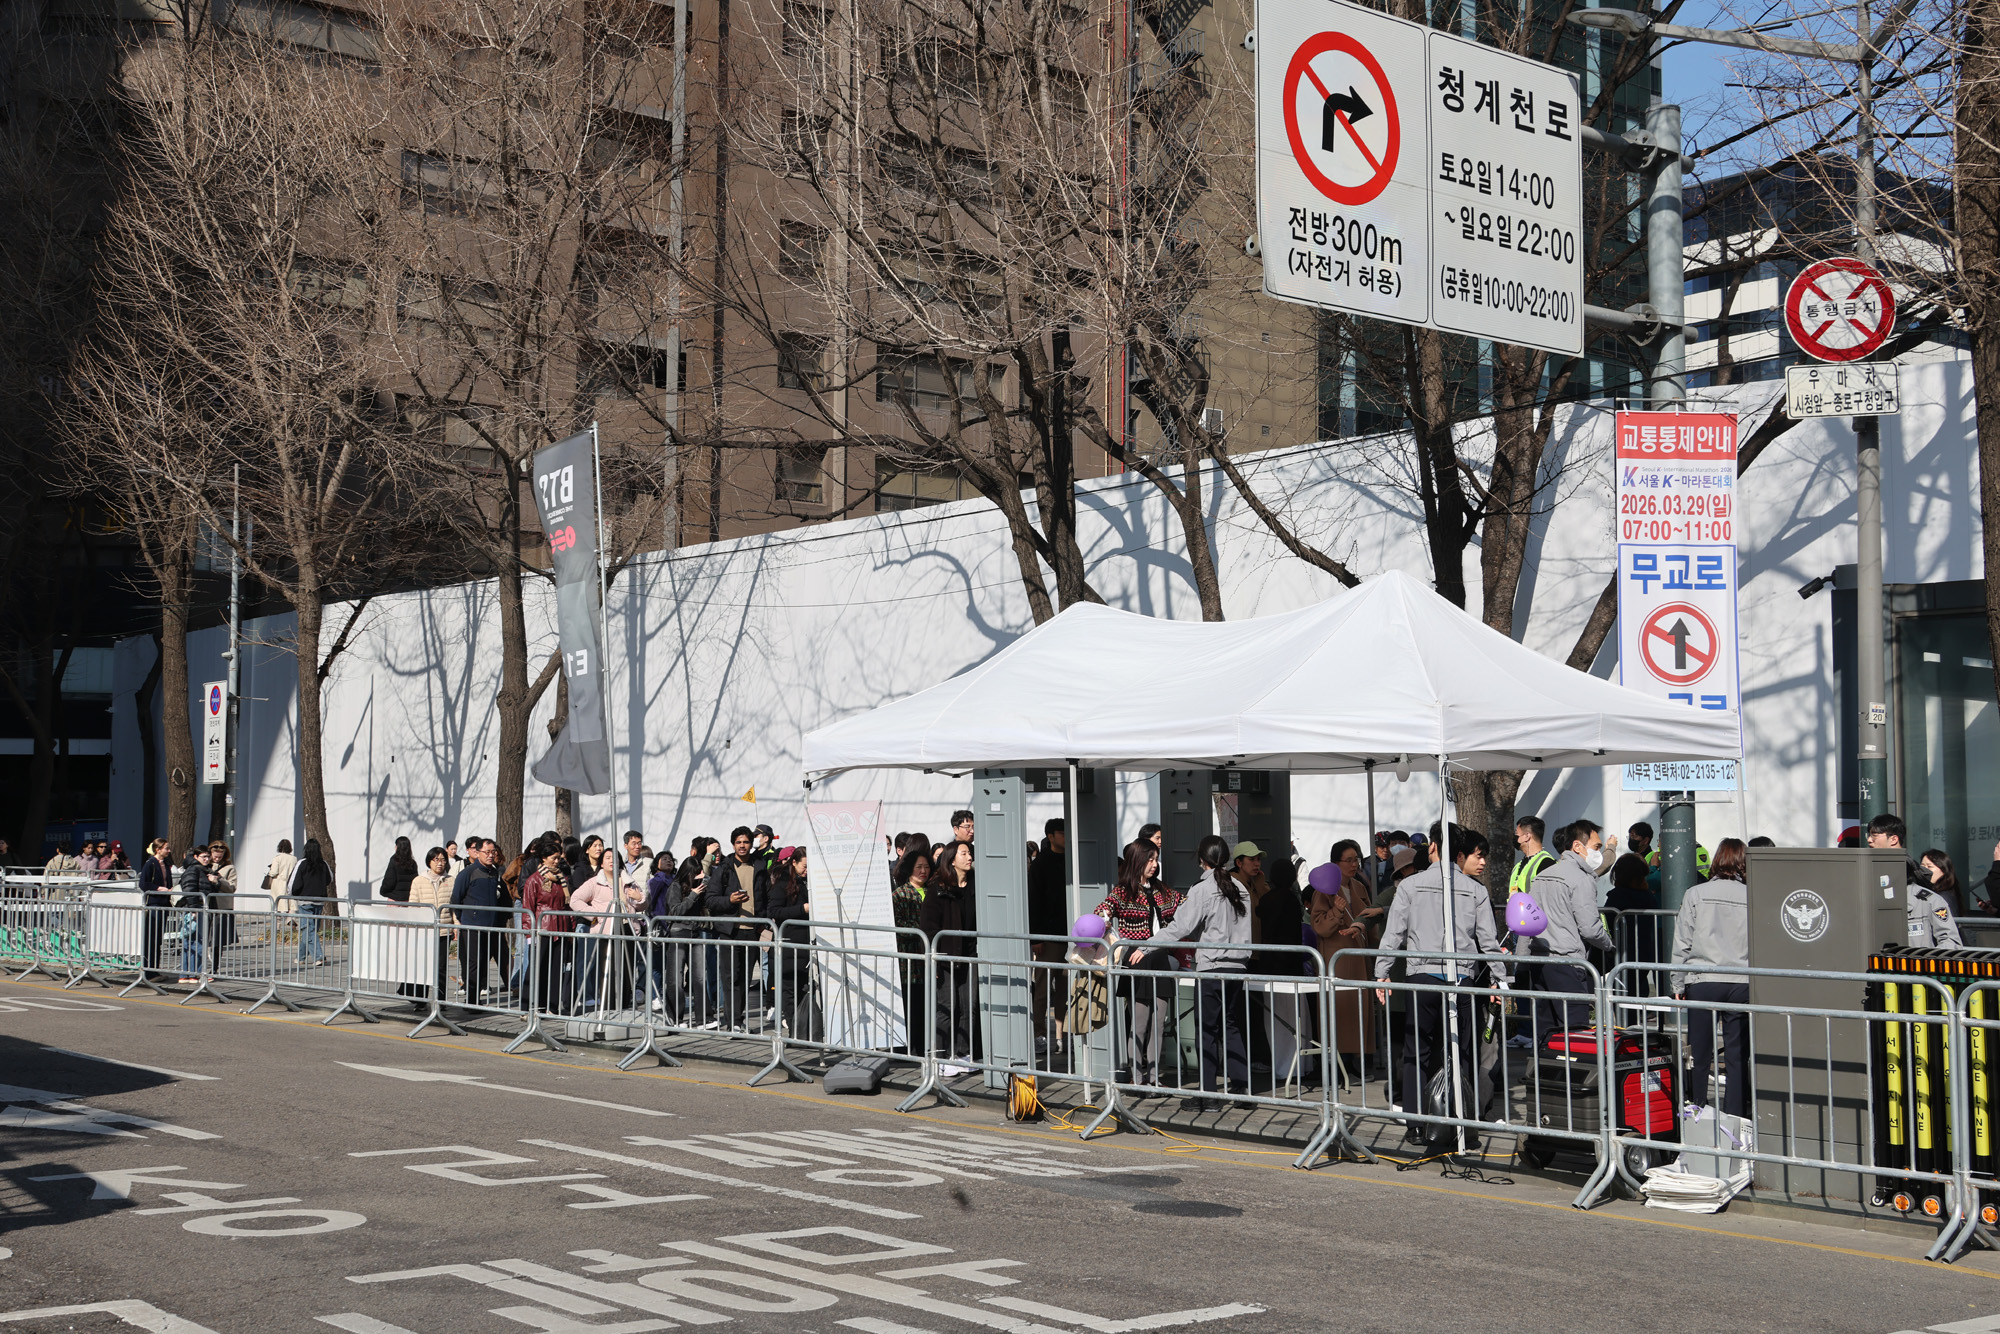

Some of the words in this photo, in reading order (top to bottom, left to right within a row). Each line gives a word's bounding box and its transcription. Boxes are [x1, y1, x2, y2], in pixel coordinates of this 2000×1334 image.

[1437, 65, 1573, 142] 청계천로
[1288, 247, 1351, 287] (자전거
[1358, 264, 1402, 298] 허용)
[1622, 424, 1732, 453] 교통통제안내
[1639, 474, 1660, 488] 서울
[1621, 493, 1732, 518] 2026.03.29(일)
[1622, 519, 1731, 541] 07:00~11:00
[1630, 553, 1727, 595] 무교로
[1873, 714, 1883, 722] 20
[1627, 763, 1651, 781] 사무국
[1526, 903, 1541, 921] BTS
[1913, 1012, 1923, 1077] OLICE
[1971, 1017, 1981, 1082] OLICE
[1917, 1088, 1925, 1131] LINE
[1975, 1094, 1983, 1138] LINE
